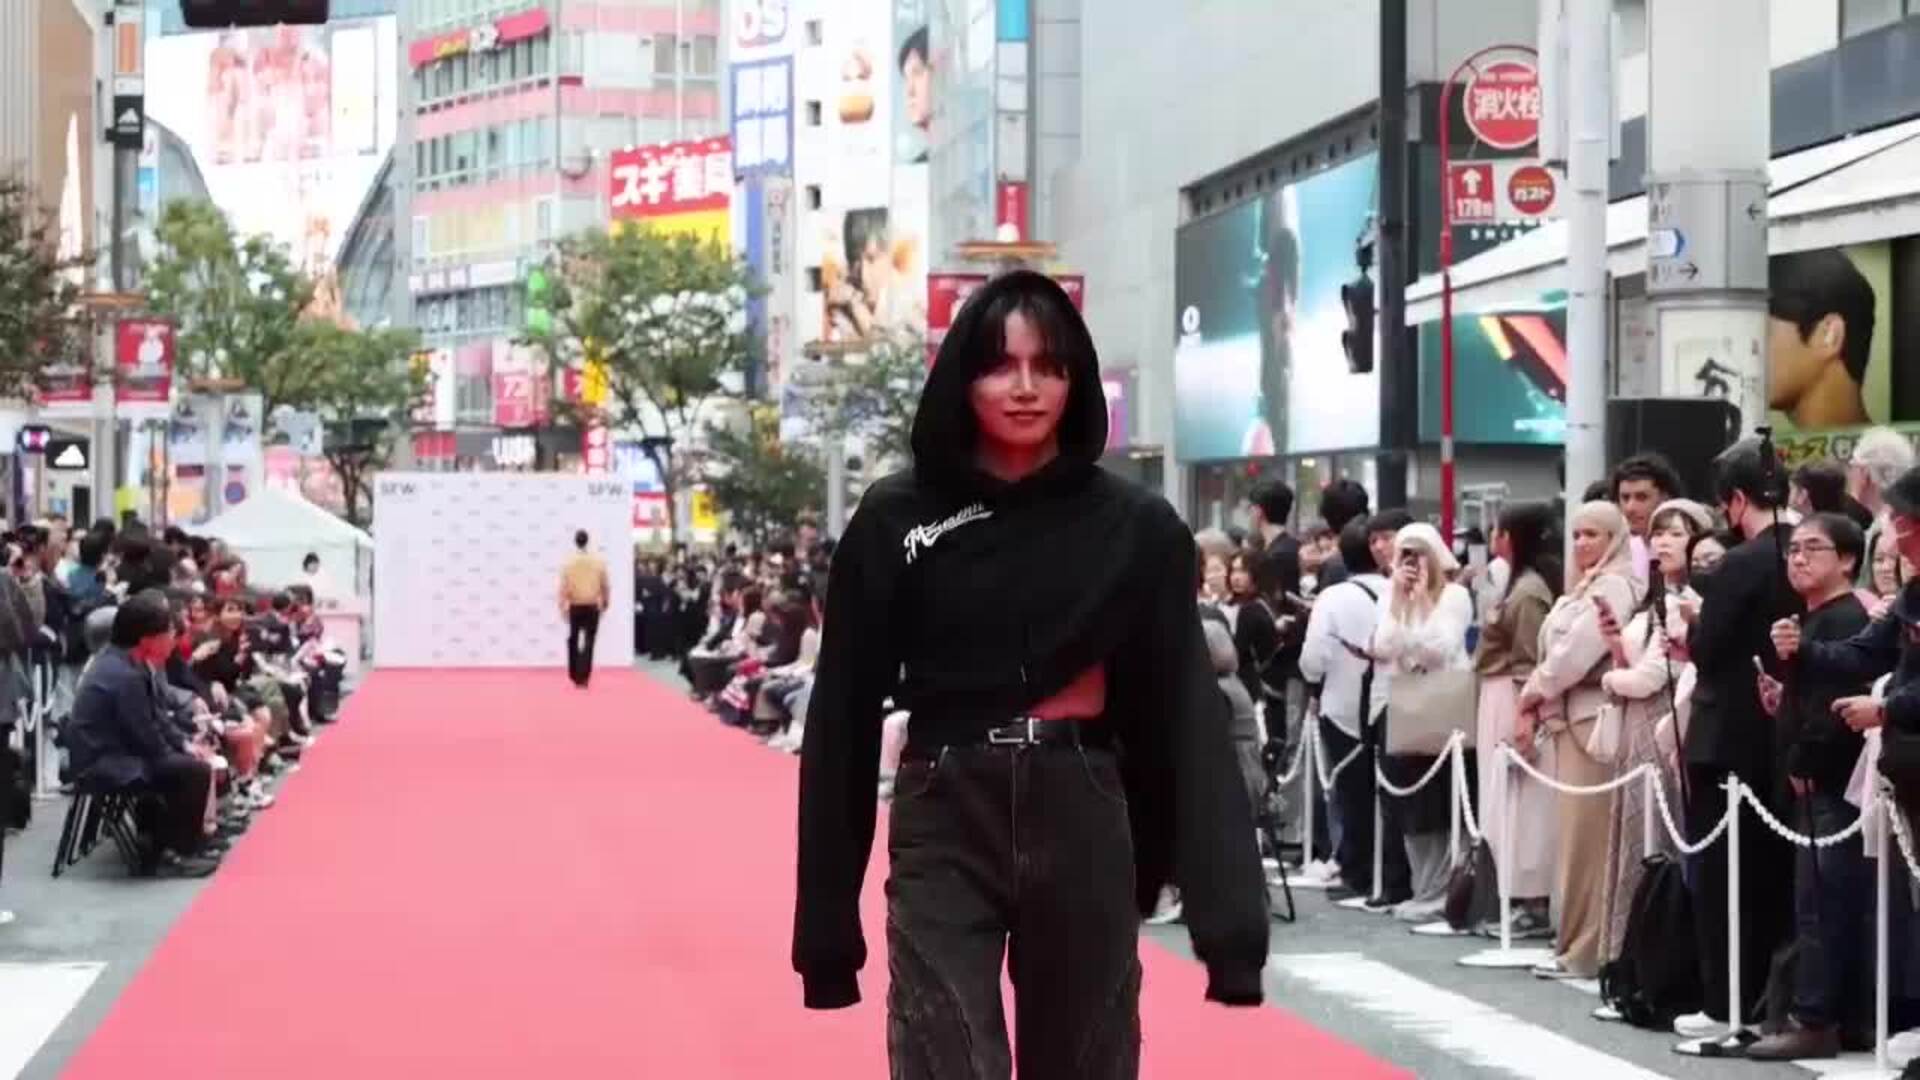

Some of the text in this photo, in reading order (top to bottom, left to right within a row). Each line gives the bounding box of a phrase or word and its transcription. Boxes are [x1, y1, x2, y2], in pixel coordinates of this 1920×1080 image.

[1473, 86, 1541, 121] 消火栓
[1514, 186, 1552, 203] ガスト
